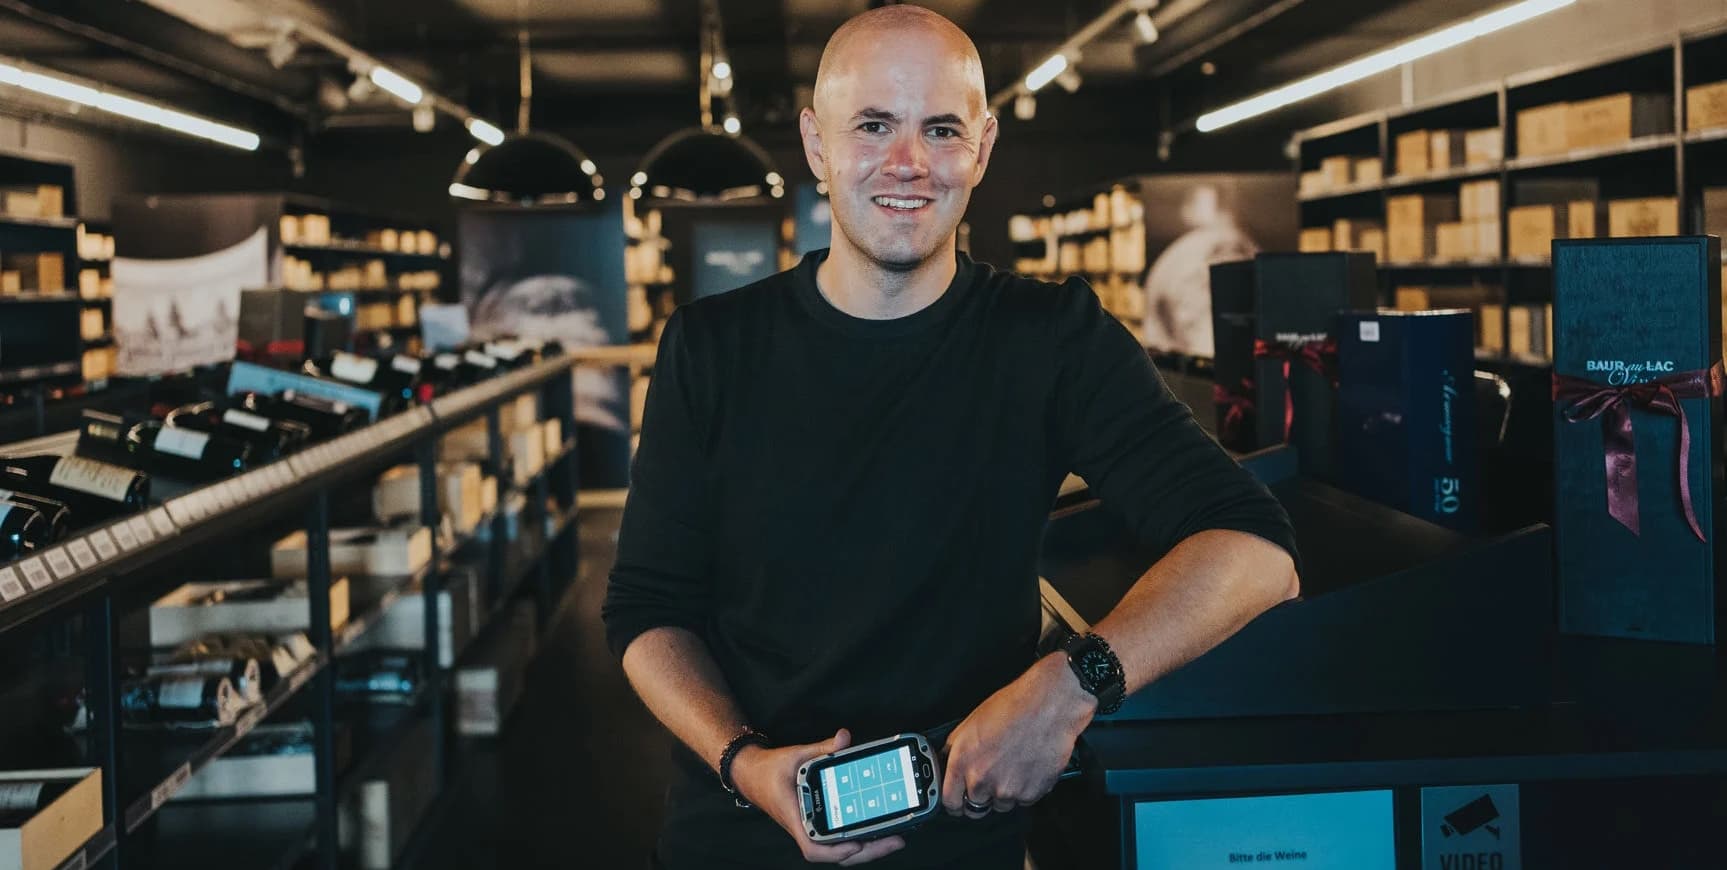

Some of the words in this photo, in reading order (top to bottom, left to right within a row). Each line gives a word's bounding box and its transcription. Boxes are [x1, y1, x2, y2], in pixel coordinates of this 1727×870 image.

[1586, 360, 1625, 371] BAUR
[1646, 360, 1674, 371] LAC
[1441, 478, 1460, 512] 50
[1229, 853, 1253, 863] Bitte
[1256, 851, 1272, 862] die
[1275, 850, 1307, 861] Weine
[1440, 853, 1503, 870] VIDEO
